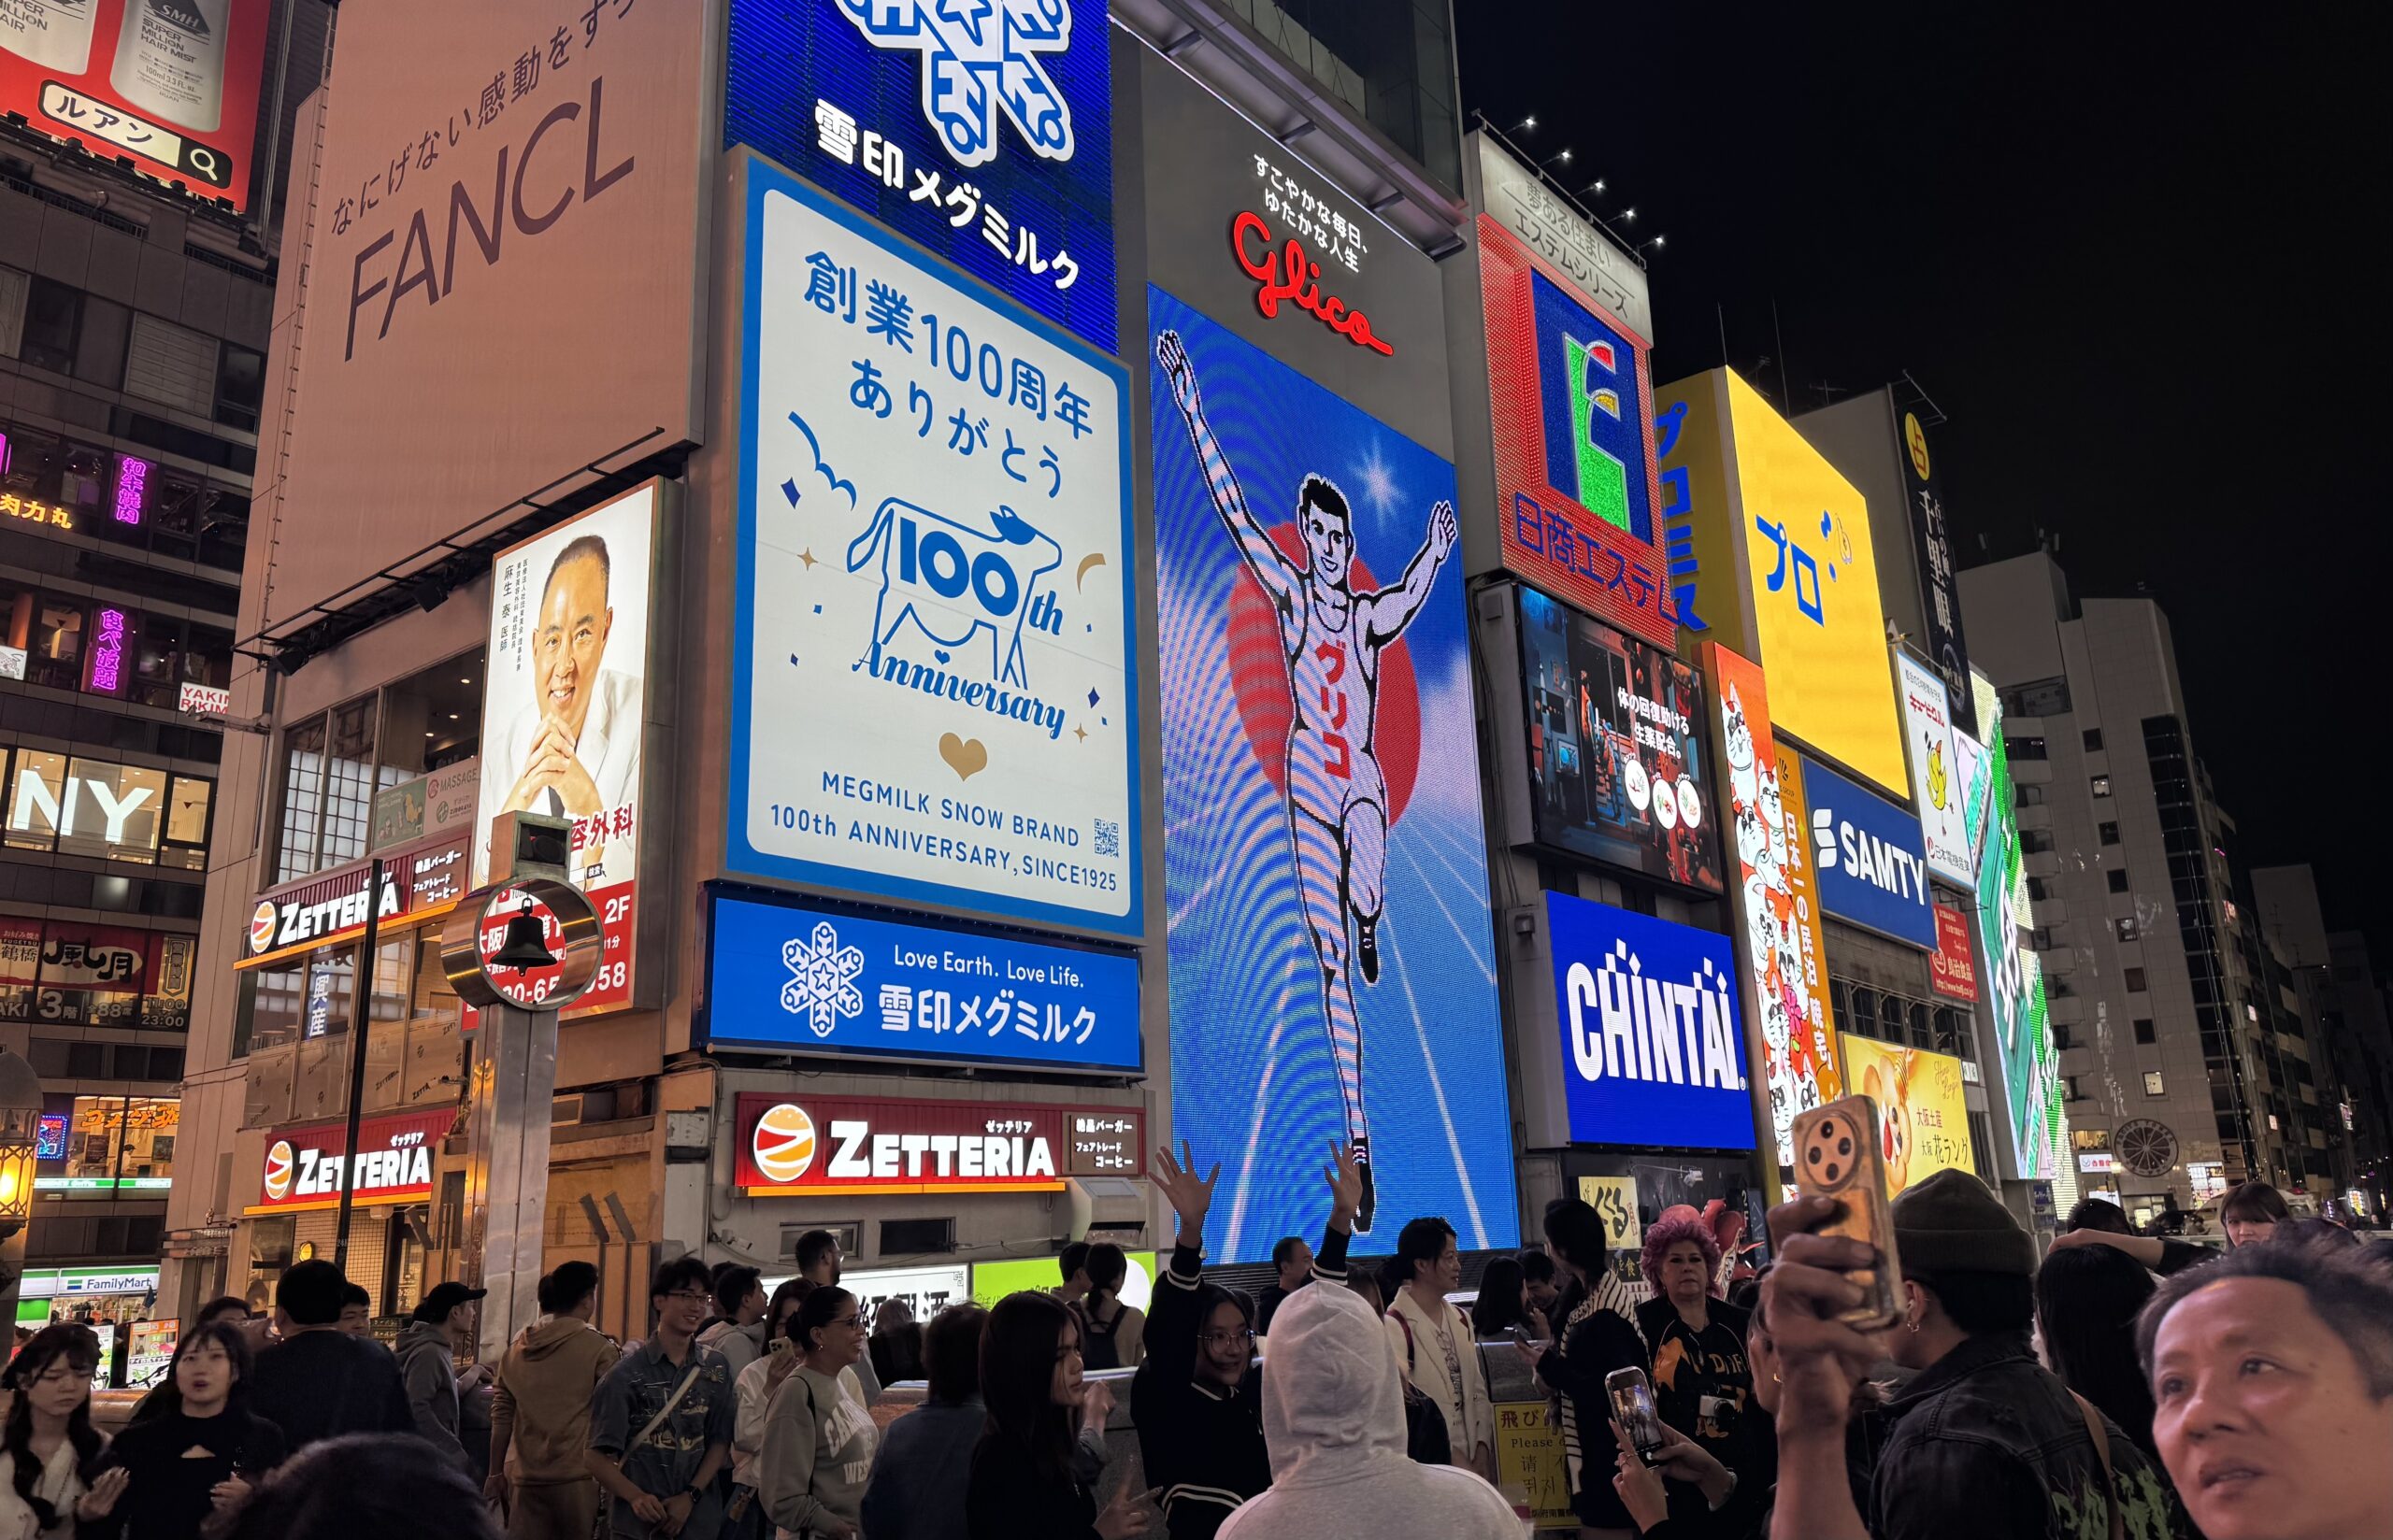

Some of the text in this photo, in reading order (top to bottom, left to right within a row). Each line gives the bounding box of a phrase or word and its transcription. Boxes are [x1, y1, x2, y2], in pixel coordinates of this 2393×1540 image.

[0, 2, 48, 31] ILLION
[141, 25, 184, 51] MILLION
[142, 18, 181, 42] SUPER
[162, 4, 199, 27] SMH
[140, 33, 197, 64] HAIR MIST
[56, 94, 153, 144] ルアン
[814, 97, 1080, 290] 雪印メグミルク
[1253, 152, 1368, 254] すこやかな毎日、
[344, 75, 636, 364] FANCL
[1264, 186, 1359, 274] ゆたかな人生
[1526, 178, 1612, 271] 夢ある住まい
[1232, 210, 1395, 357] Glico
[1514, 206, 1628, 321] エステムシリーズ
[804, 250, 1094, 440] 創業100周年
[850, 358, 1062, 499] ありがとう
[1652, 400, 1711, 633] プロミス
[1513, 490, 1683, 628] 日商エステム
[93, 608, 124, 691] 食べ放題
[852, 640, 1066, 740] Anniversary
[1315, 638, 1352, 780] グリコ
[1617, 685, 1690, 735] 体の回復助ける
[1634, 721, 1682, 760] 生薬配合。
[439, 767, 479, 793] MASSAGE
[12, 768, 155, 845] NY
[570, 803, 635, 852] 容外科
[770, 804, 838, 837] 100th
[823, 771, 1080, 848] MEGMILK SNOW BRAND
[1841, 820, 1926, 906] SAMTY
[278, 881, 400, 946] ZETTERA
[426, 885, 459, 904] コーヒー
[604, 895, 631, 924] 2F
[43, 935, 135, 983] 風月
[894, 944, 1084, 989] Love Earth. Love Life.
[142, 1015, 185, 1027] 23:00
[879, 983, 1097, 1046] 雪印メグミルク
[1566, 938, 1741, 1091] CHINTAI
[827, 1119, 1056, 1178] ZETTERIA
[985, 1119, 1033, 1134] ゼッテリア
[1075, 1118, 1134, 1134] 絶品バーガー
[1075, 1142, 1123, 1153] フェアトレード
[295, 1146, 432, 1195] ZETTERIA
[1095, 1155, 1134, 1169] コーヒー
[87, 1276, 152, 1290] FamilyMart
[1512, 1437, 1554, 1448] Please
